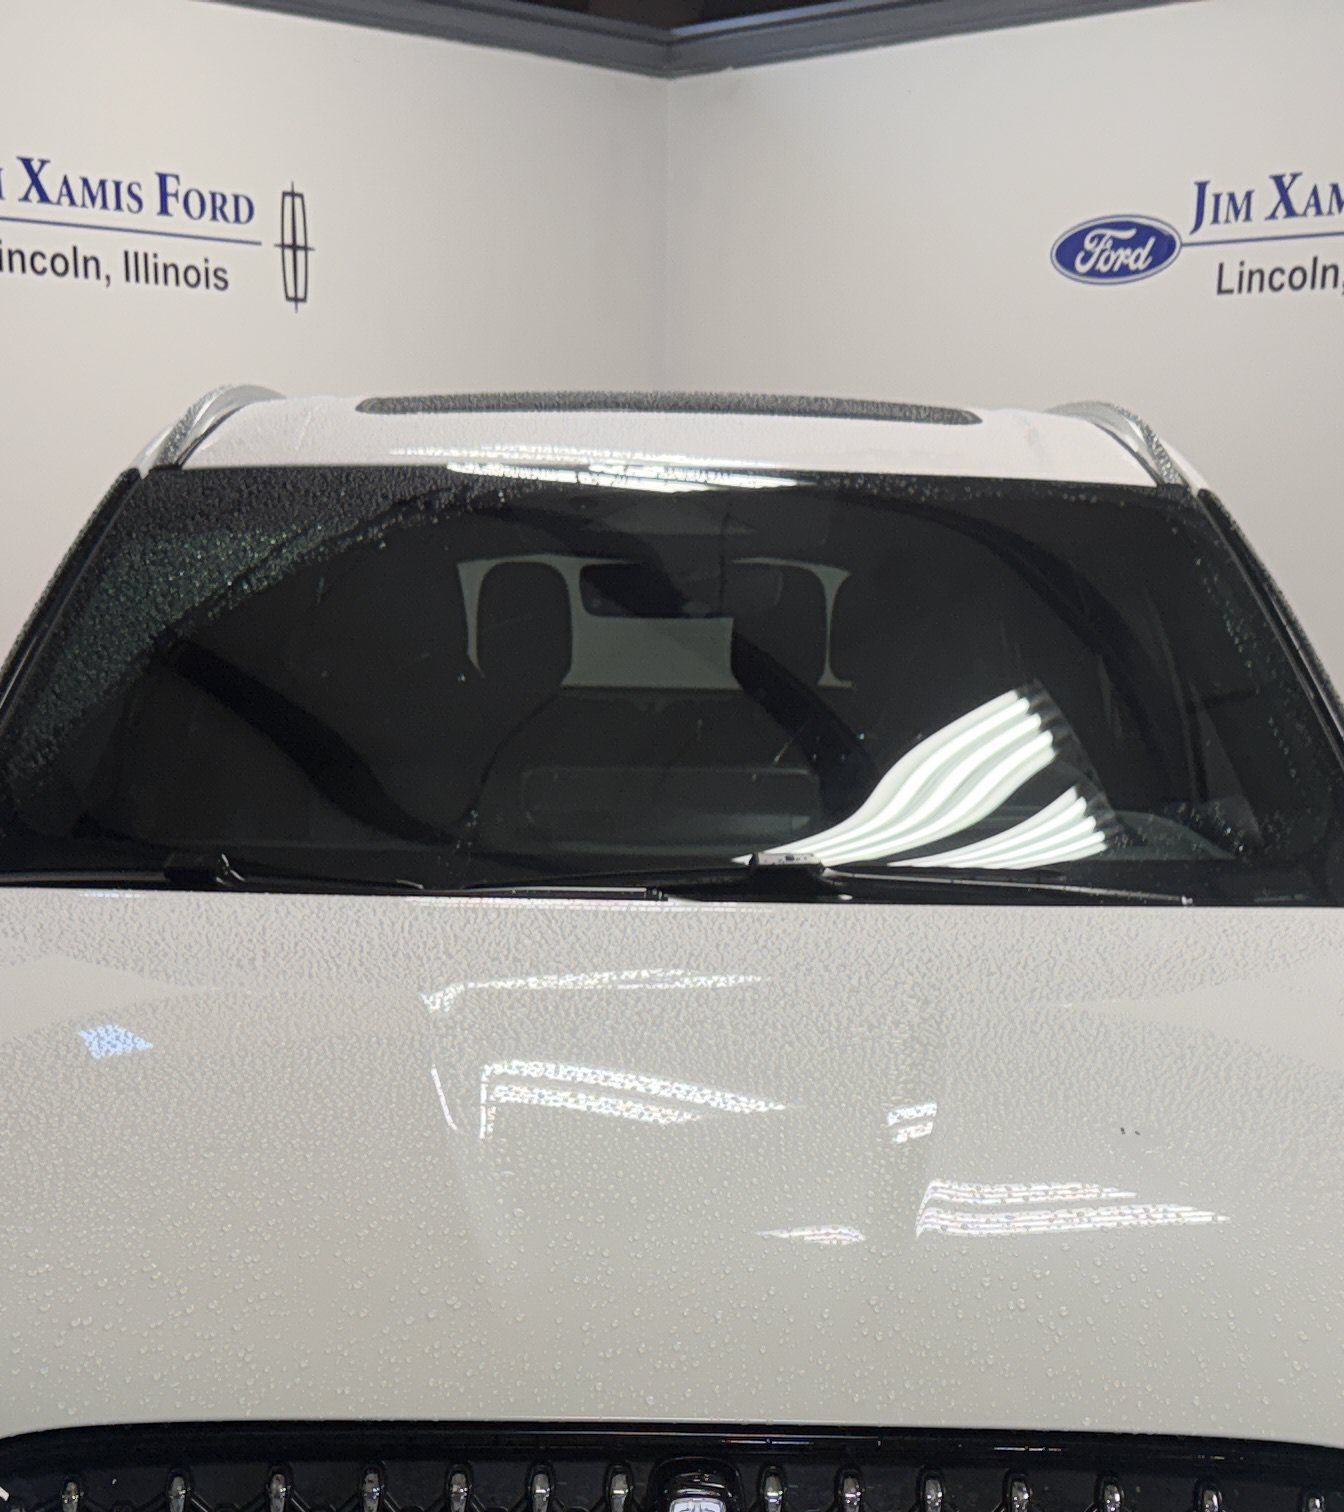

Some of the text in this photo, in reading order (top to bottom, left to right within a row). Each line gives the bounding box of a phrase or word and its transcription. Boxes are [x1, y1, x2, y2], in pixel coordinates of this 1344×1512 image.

[17, 157, 143, 213] XAMIS
[156, 172, 254, 224] FORD
[1190, 181, 1254, 234] JIM
[124, 250, 228, 291] Illinois
[1075, 228, 1156, 274] Ford
